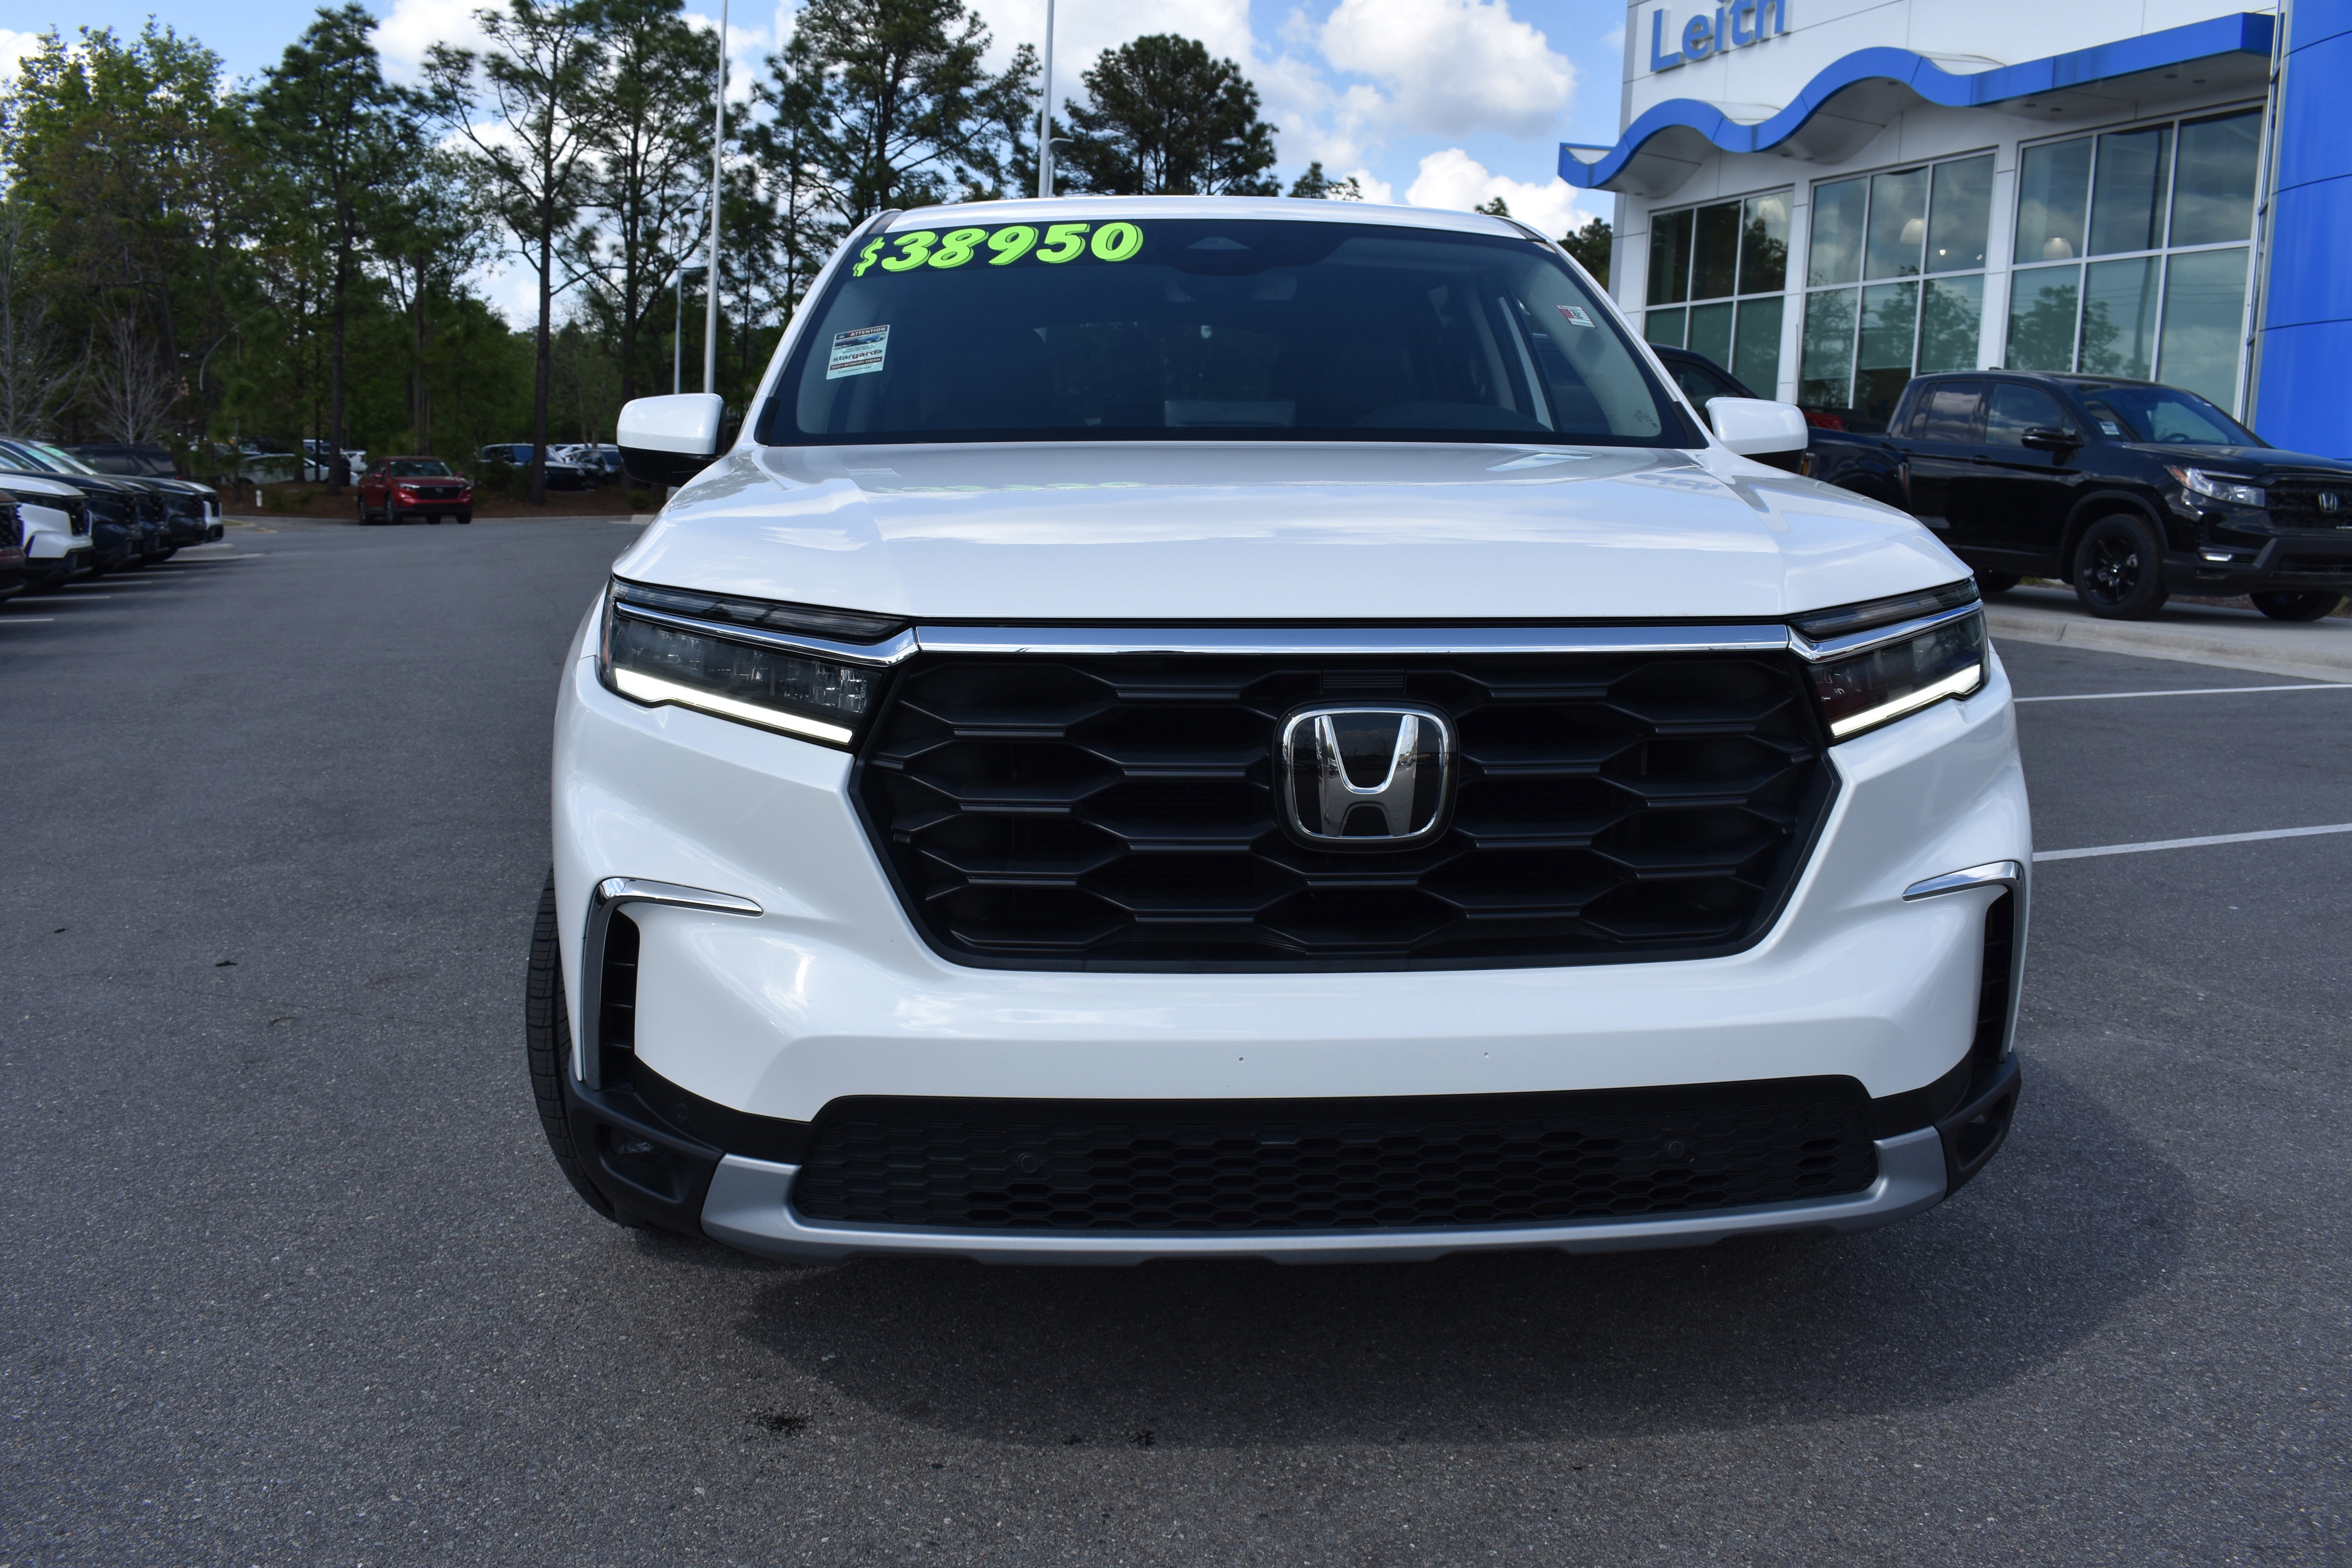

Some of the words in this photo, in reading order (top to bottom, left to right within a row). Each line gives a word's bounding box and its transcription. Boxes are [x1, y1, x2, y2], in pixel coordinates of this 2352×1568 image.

[1650, 0, 1787, 72] Leith
[852, 222, 1144, 277] $38950
[850, 327, 886, 336] ATTENTION
[833, 350, 877, 362] stargard
